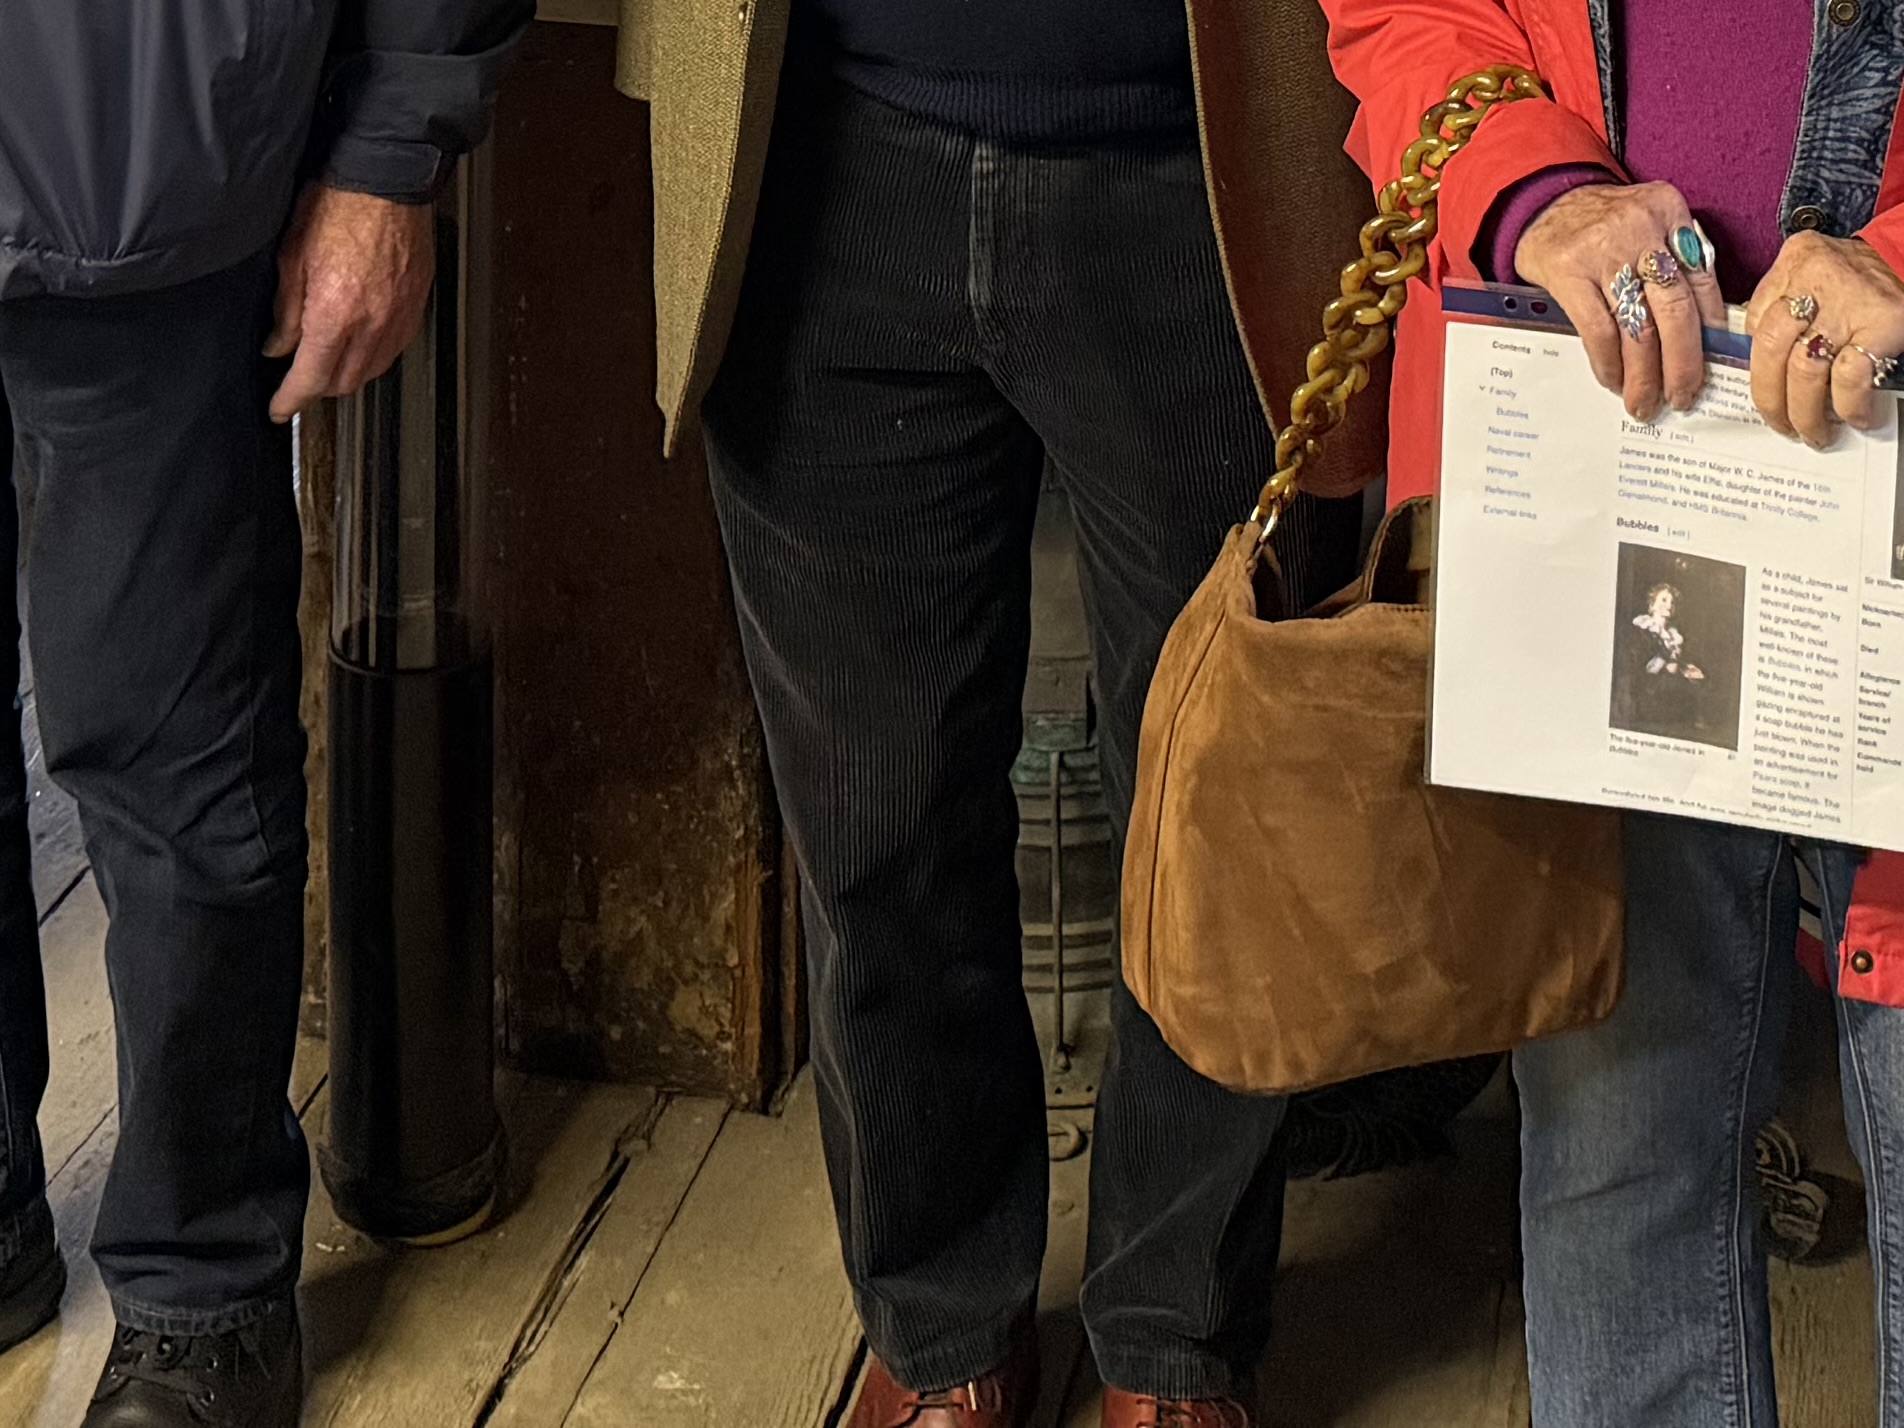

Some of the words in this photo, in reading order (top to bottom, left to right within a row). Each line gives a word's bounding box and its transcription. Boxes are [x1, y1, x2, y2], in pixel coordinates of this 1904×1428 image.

[1492, 341, 1531, 354] Contents
[1491, 366, 1513, 379] (Top)
[1489, 386, 1516, 400] Family
[1621, 420, 1663, 440] Family
[1616, 516, 1659, 533] Bubbles
